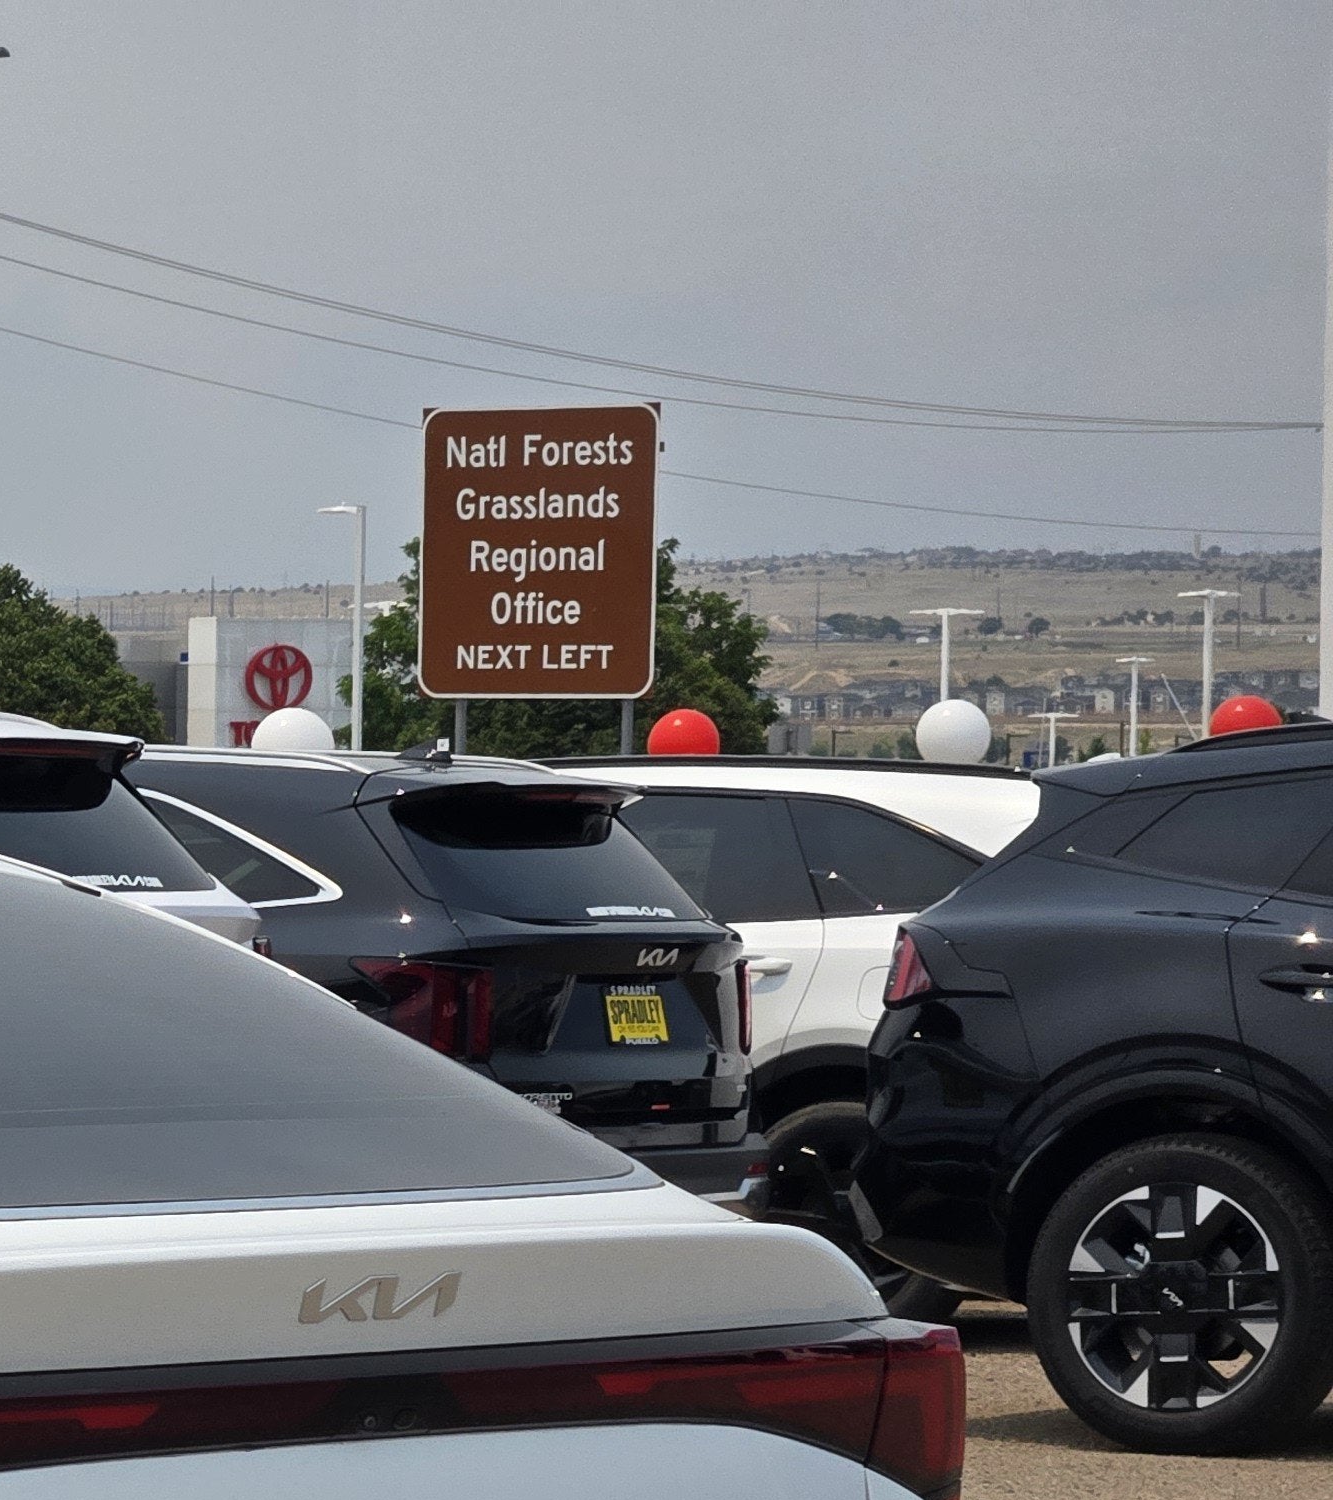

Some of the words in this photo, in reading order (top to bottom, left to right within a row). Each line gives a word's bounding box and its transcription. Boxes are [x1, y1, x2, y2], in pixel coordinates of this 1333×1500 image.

[446, 435, 506, 469] Natl
[523, 433, 633, 467] Forests
[456, 485, 620, 520] Grasslands
[470, 538, 605, 583] Regional
[491, 591, 581, 625] Office
[456, 644, 532, 669] NEXT
[542, 644, 614, 669] LEFT
[610, 985, 656, 996] SPRADLEY
[609, 999, 662, 1025] SPRADLEY
[298, 1270, 463, 1324] KIA
